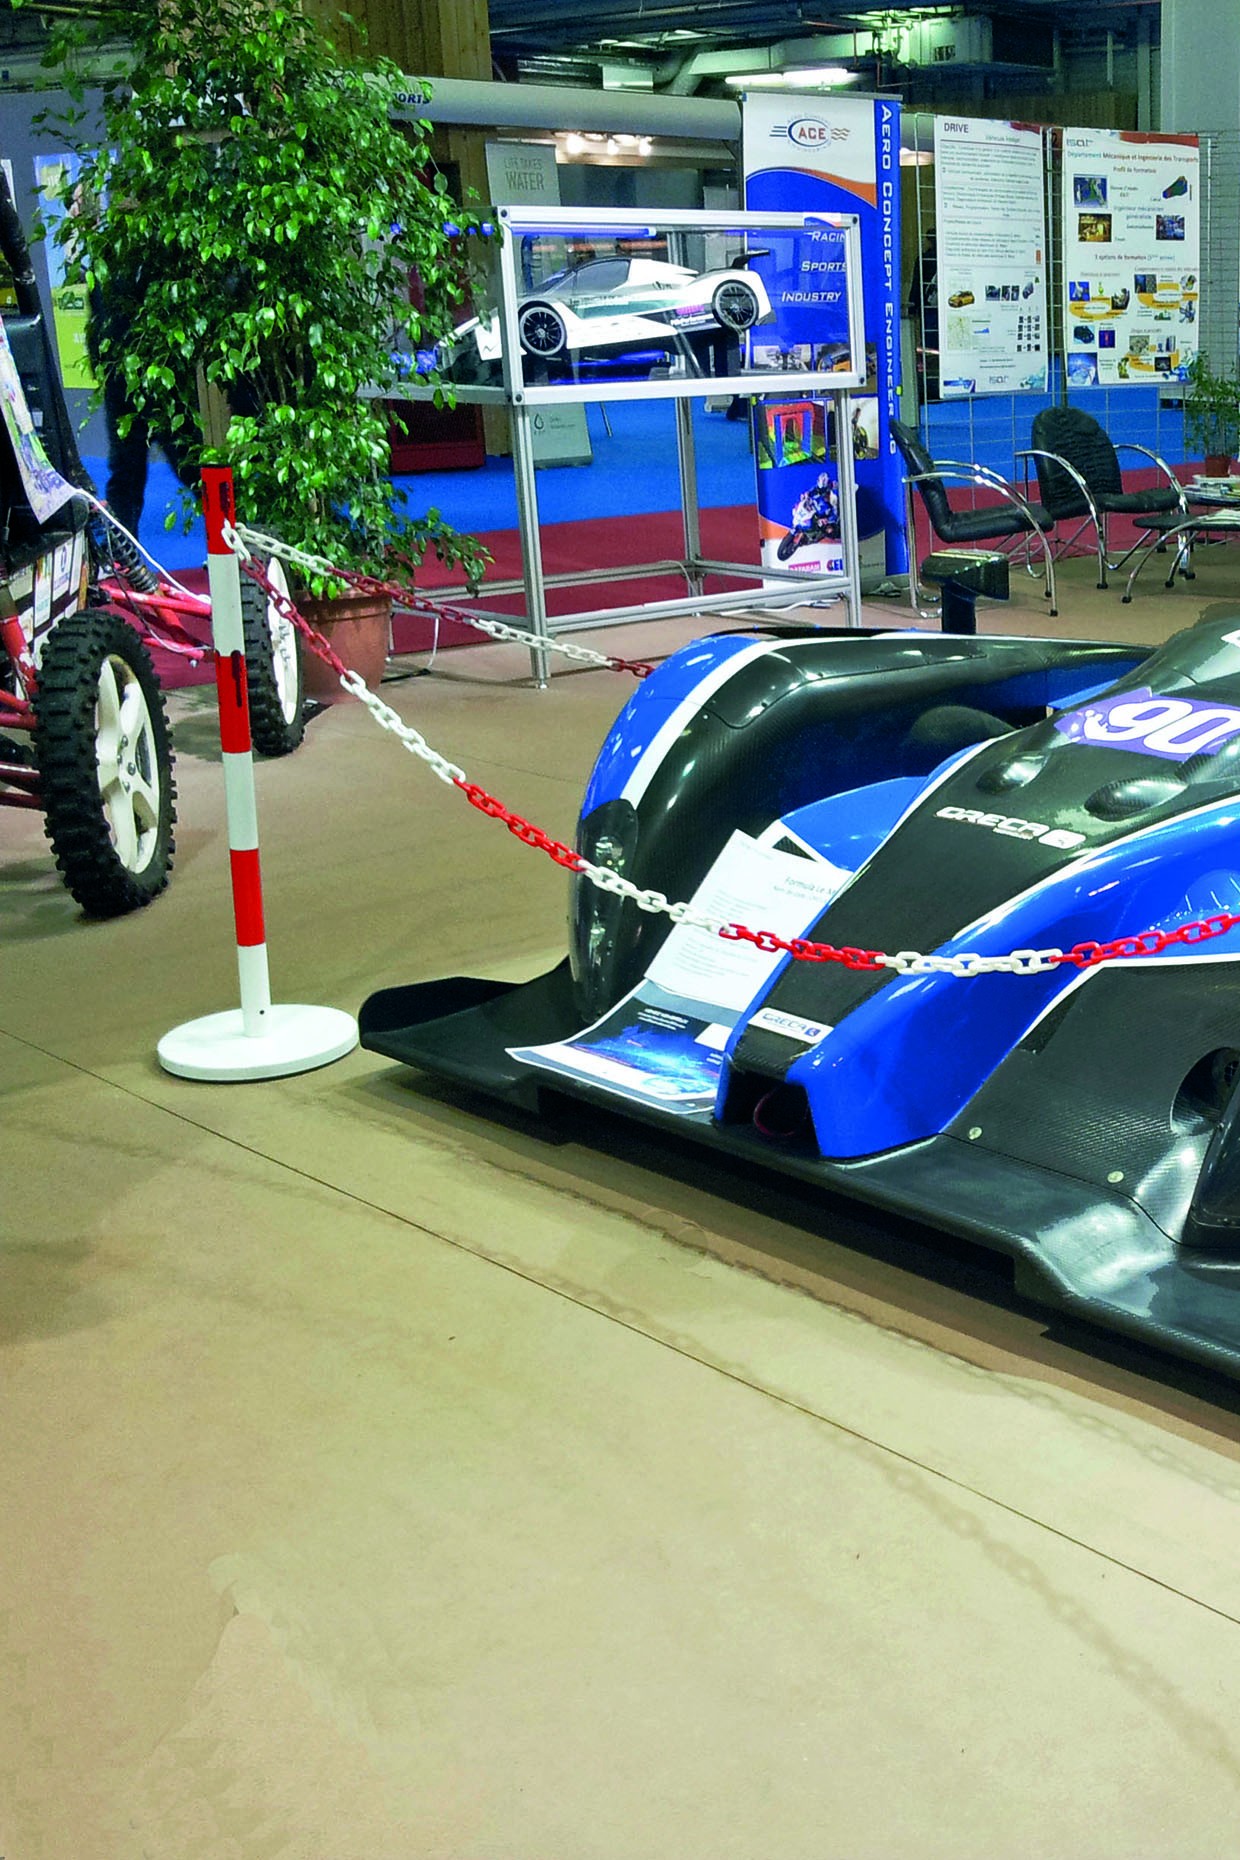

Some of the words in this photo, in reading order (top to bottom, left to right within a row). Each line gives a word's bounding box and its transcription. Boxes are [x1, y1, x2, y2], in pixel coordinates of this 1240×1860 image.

[798, 126, 827, 140] ACE
[881, 104, 893, 170] AERO
[944, 122, 969, 133] DRIVE
[505, 170, 545, 191] WATER
[882, 181, 894, 291] CONCEPT
[781, 290, 842, 303] INDUSTRY
[884, 302, 897, 455] ENGINEERG
